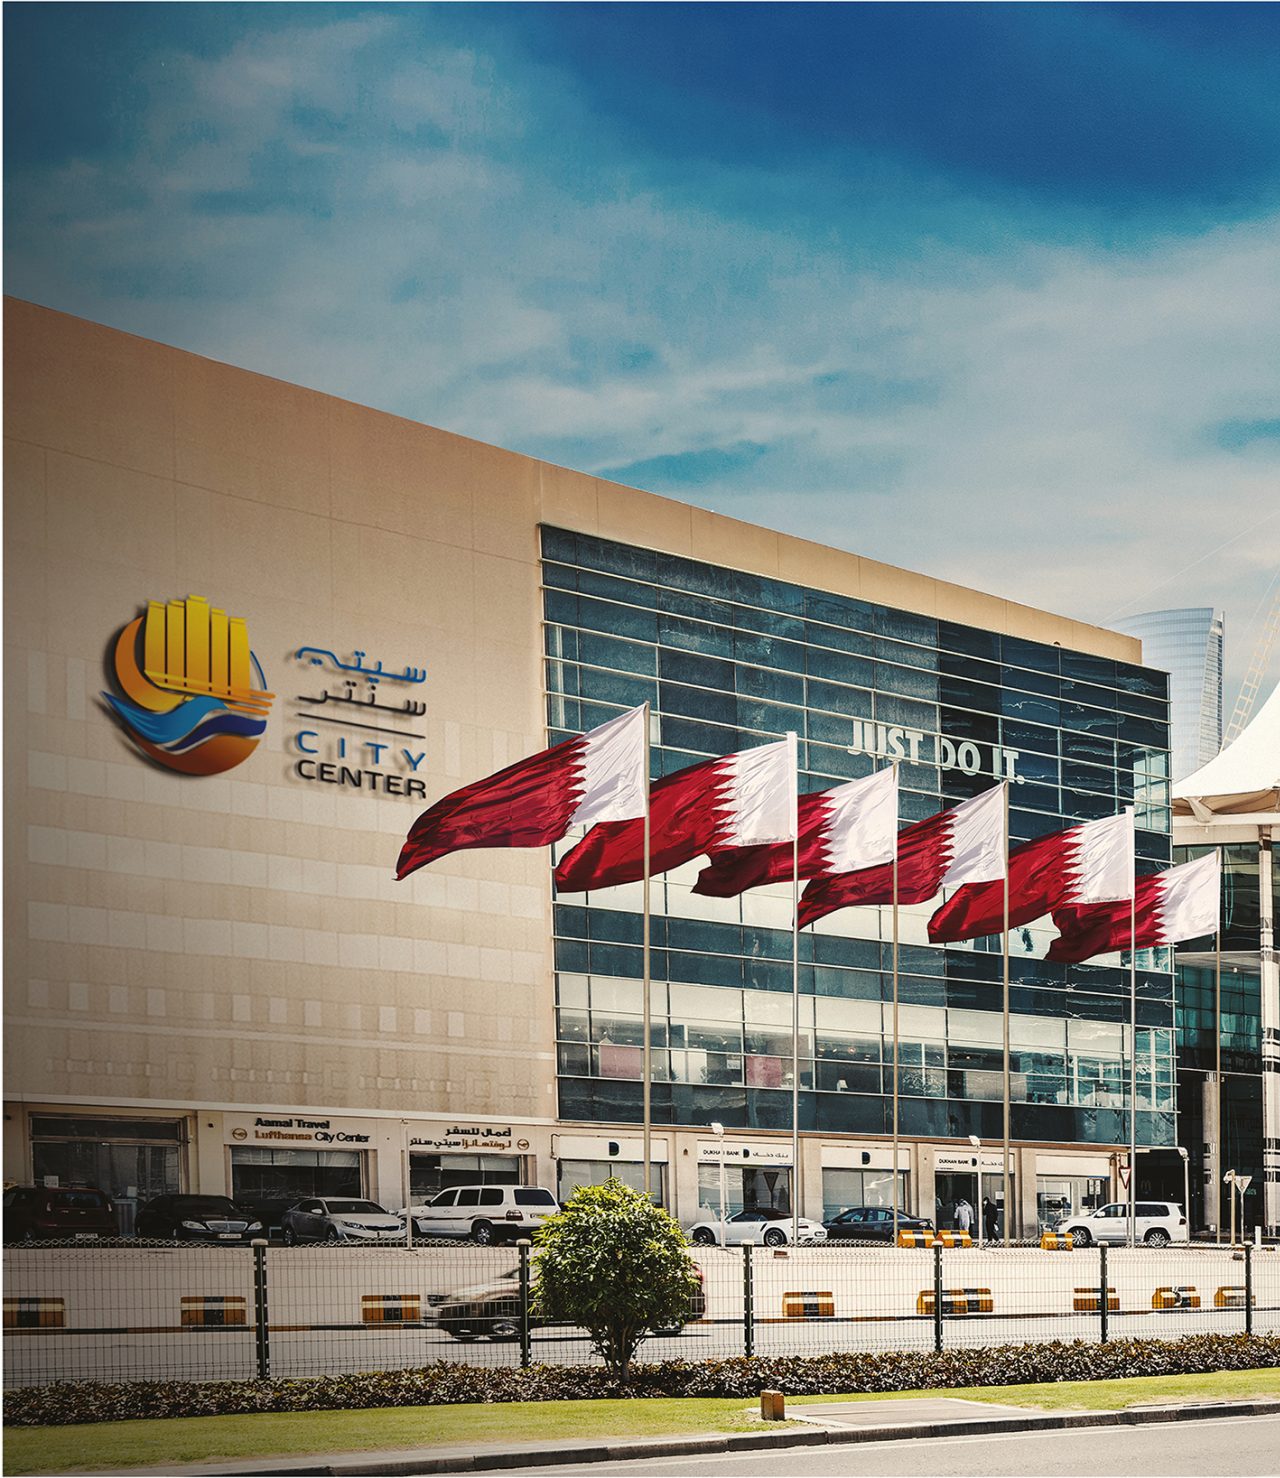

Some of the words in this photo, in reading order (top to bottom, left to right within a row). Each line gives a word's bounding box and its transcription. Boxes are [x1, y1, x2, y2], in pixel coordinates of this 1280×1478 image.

[295, 647, 427, 684] سيتي
[298, 681, 427, 716] سنتر
[297, 731, 427, 771] CITY
[848, 720, 923, 765] JUST
[935, 735, 981, 777] DO
[297, 759, 427, 799] CENTER
[255, 1117, 293, 1128] Aamal
[295, 1119, 330, 1129] Travel
[255, 1130, 312, 1140] Lufthansa
[314, 1131, 335, 1143] City
[336, 1132, 370, 1143] Center
